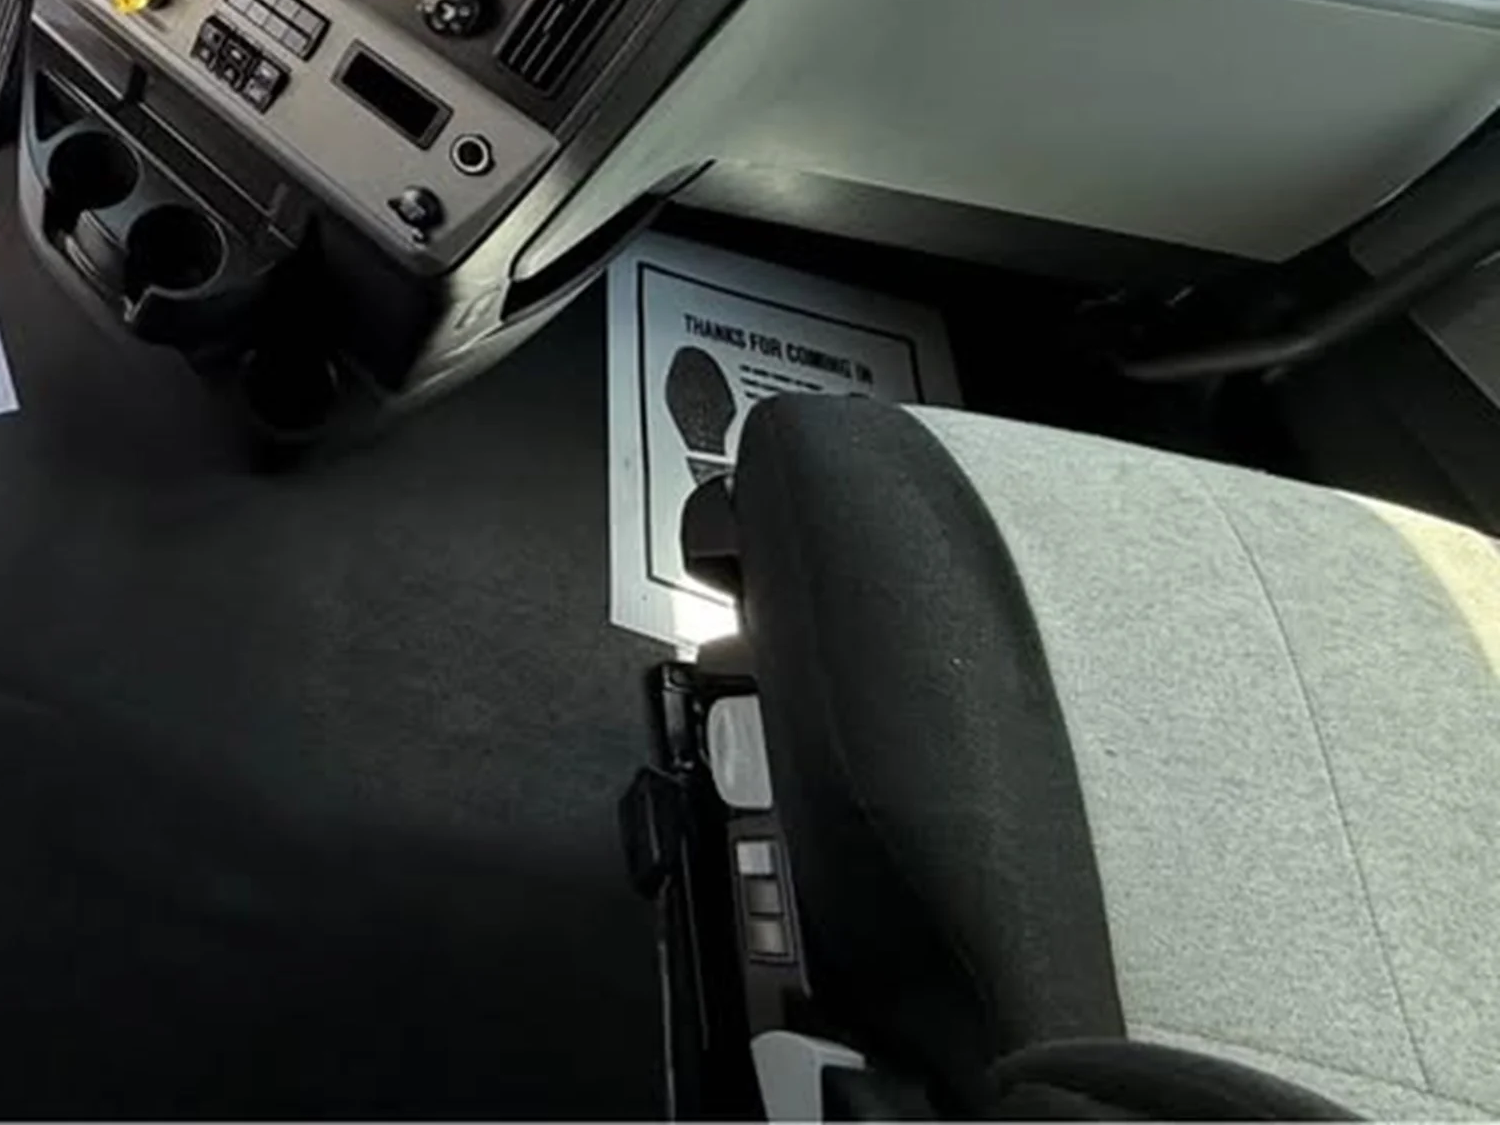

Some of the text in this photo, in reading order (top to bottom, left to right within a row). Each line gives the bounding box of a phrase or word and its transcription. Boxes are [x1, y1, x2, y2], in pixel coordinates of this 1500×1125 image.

[684, 313, 747, 349] THANKS
[749, 332, 784, 360] FOR
[786, 342, 852, 379] COMING
